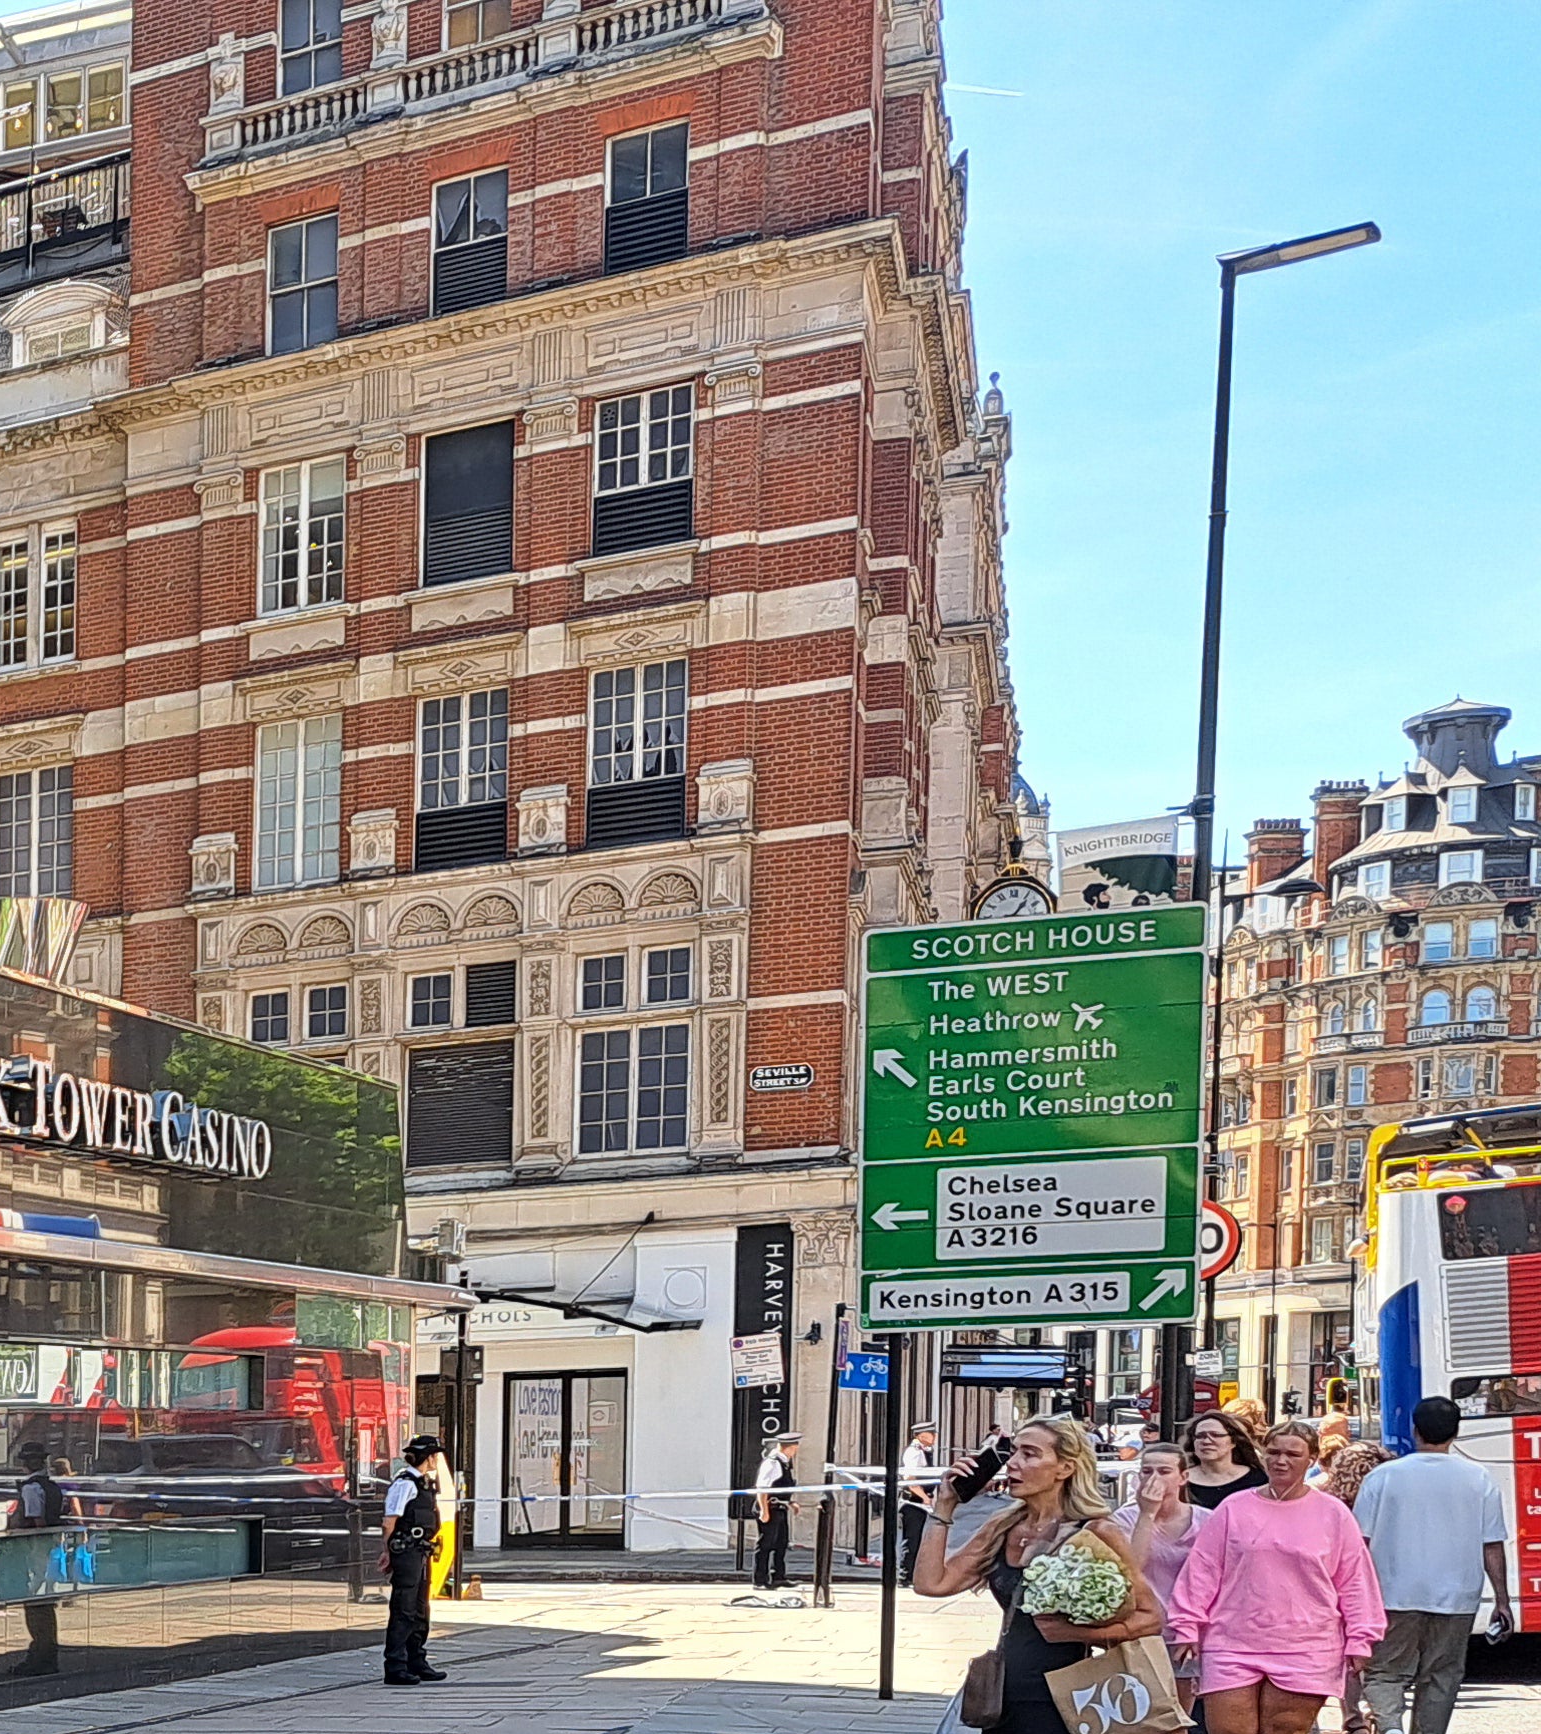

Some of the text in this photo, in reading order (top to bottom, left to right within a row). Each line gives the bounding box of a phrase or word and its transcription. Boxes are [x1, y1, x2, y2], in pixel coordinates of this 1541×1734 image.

[912, 919, 1157, 960] SCOTCH HOUSE
[928, 971, 1069, 1002] The WEST
[929, 1008, 1061, 1036] Heathrow
[929, 1038, 1118, 1071] Hammersmith
[755, 1066, 807, 1078] SEVILLE
[929, 1067, 1086, 1096] Earls Court
[28, 1053, 154, 1157] TOWER
[161, 1091, 273, 1181] CASINO
[926, 1090, 1174, 1122] South Kensington
[947, 1174, 1058, 1196] Chelsea
[946, 1194, 1157, 1223] Sloane Square
[879, 1284, 1032, 1310] Kensington
[443, 1309, 533, 1326] NCHOLS
